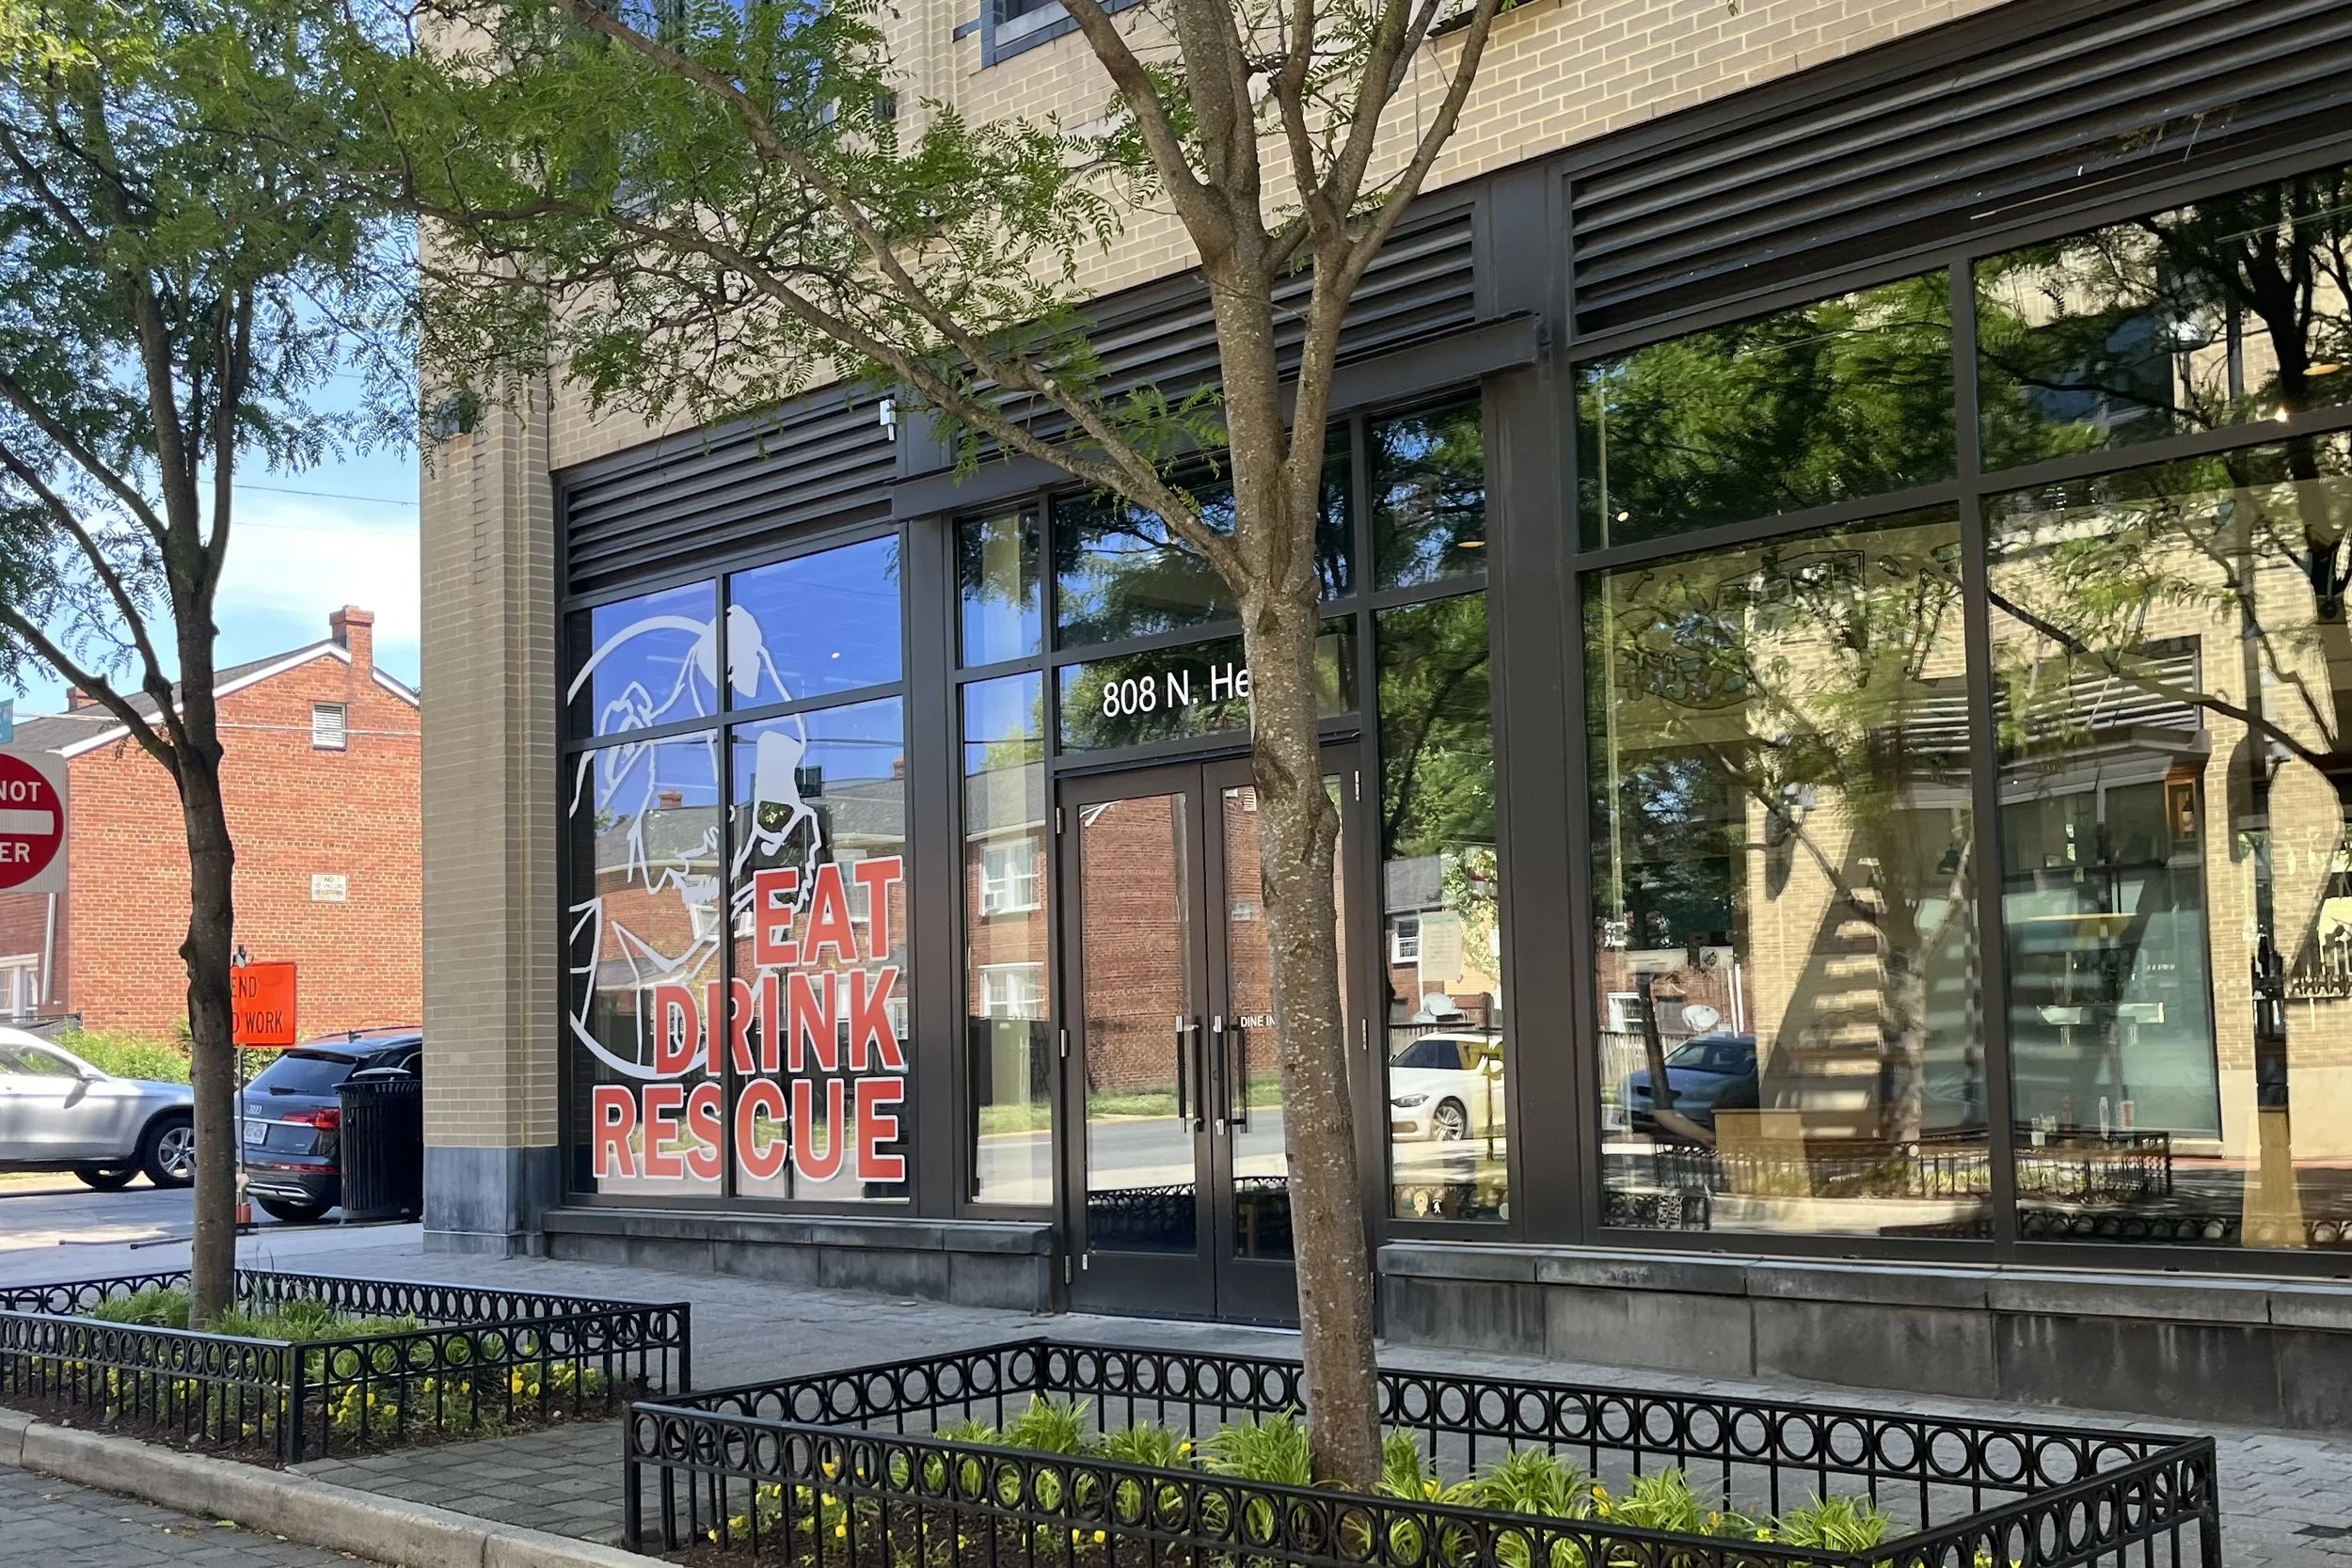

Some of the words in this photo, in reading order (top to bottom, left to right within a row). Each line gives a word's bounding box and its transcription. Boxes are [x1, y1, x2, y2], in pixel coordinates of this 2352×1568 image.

[1103, 675, 1156, 718] 808
[1167, 669, 1199, 708] N.
[754, 855, 903, 967] EAT
[246, 1010, 283, 1034] WORK
[654, 965, 905, 1075] DRINK
[1240, 1015, 1264, 1028] DINE
[593, 1076, 905, 1182] RESCUE
